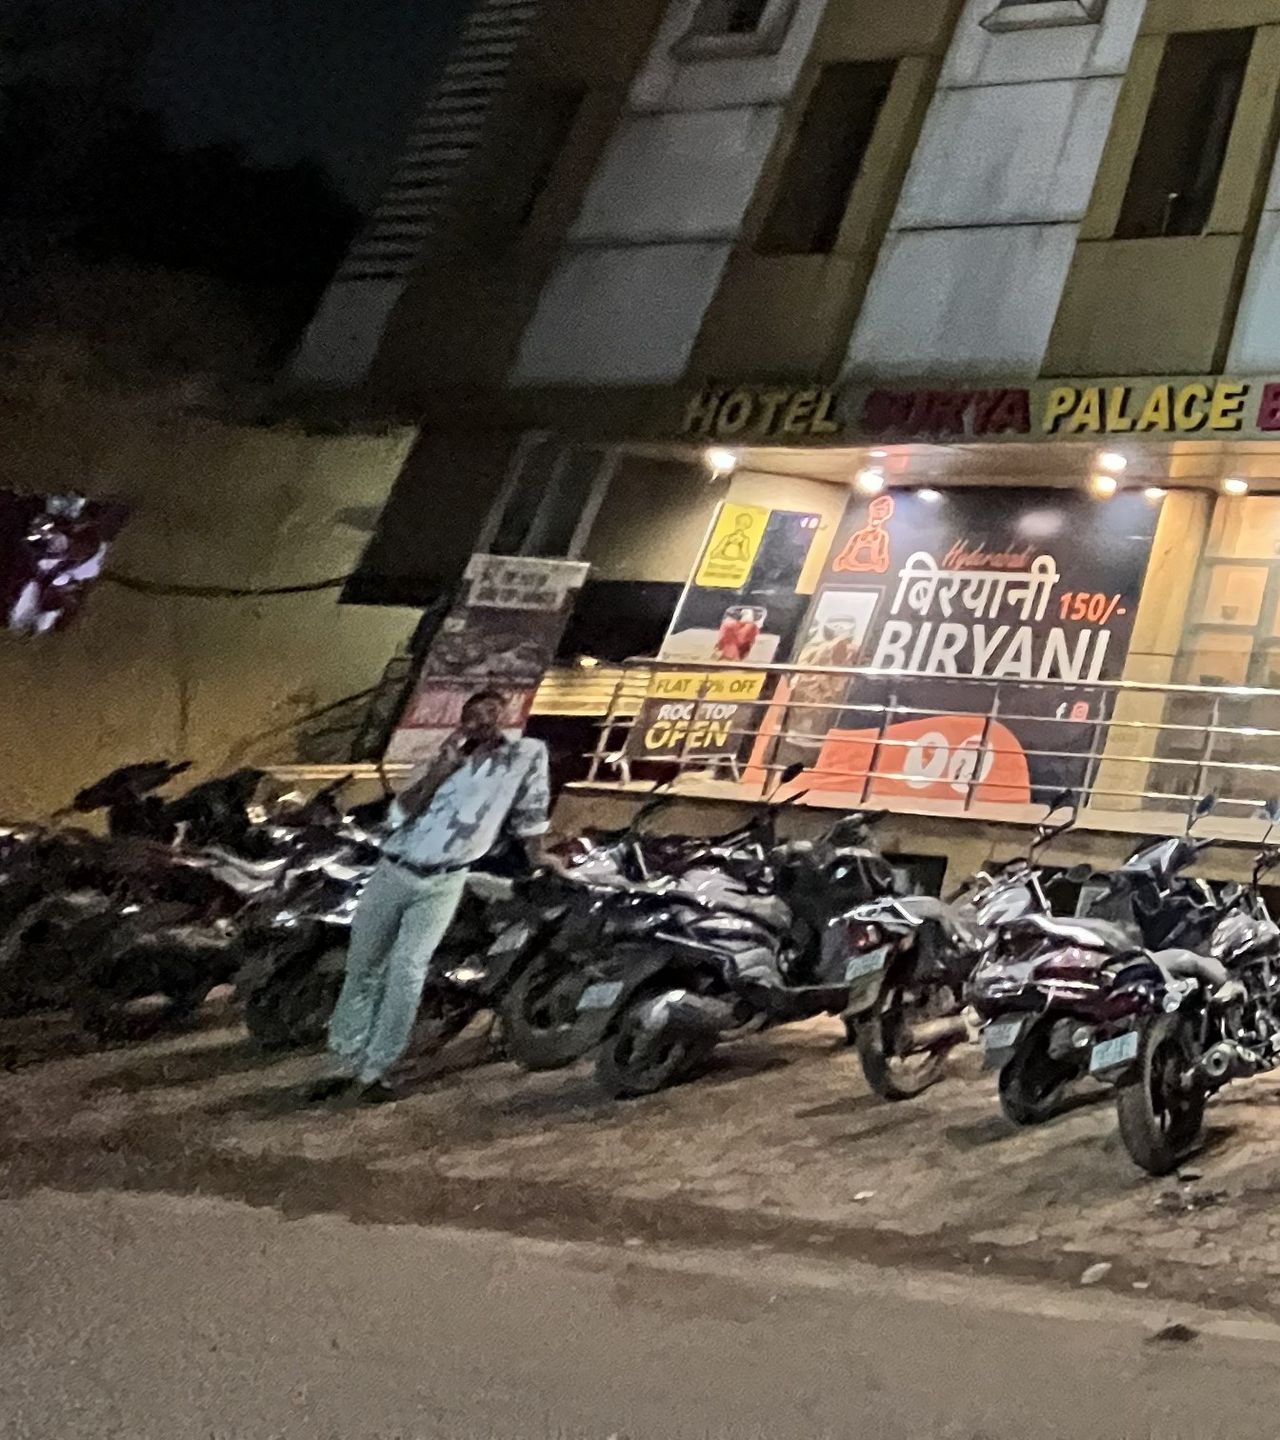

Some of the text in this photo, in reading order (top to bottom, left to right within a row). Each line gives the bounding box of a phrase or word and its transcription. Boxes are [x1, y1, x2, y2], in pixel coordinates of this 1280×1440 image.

[680, 387, 843, 435] HOTEL
[1042, 382, 1250, 435] PALACE
[890, 551, 1060, 621] बिरयानी
[1059, 591, 1127, 625] 150/-
[871, 619, 1111, 692] BIRYANI
[656, 678, 692, 693] FLAT
[730, 678, 758, 693] OFF
[657, 703, 738, 721] ROOTOP
[645, 719, 733, 750] OPEN
